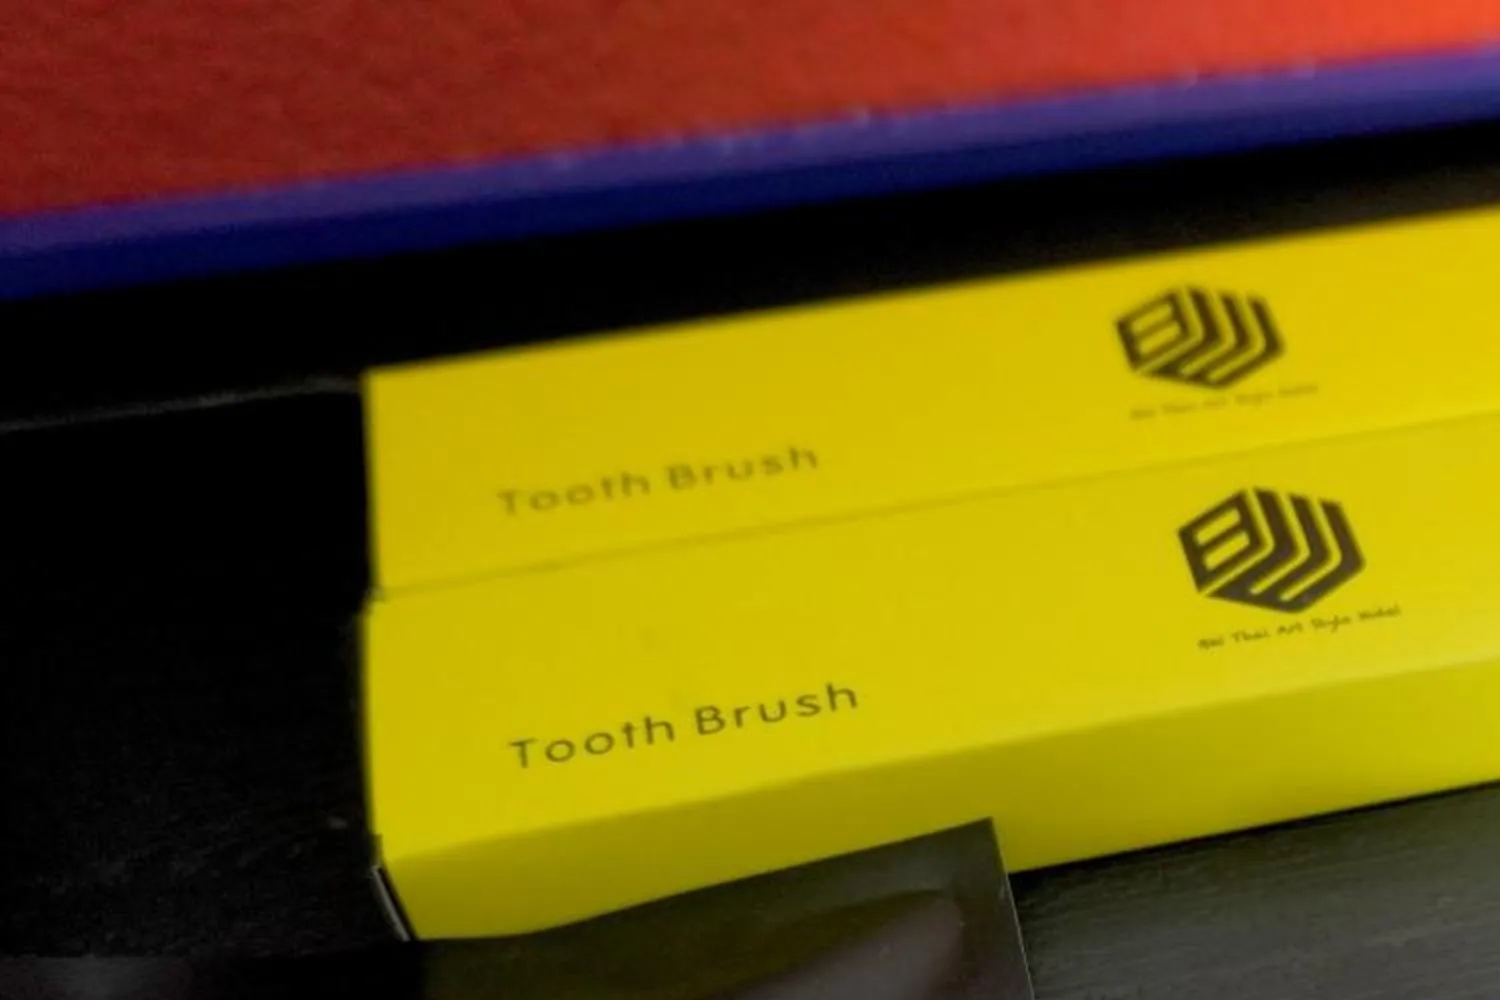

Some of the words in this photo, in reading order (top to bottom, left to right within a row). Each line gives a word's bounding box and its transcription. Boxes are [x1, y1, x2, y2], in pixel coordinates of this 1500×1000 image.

[497, 471, 651, 516] Tooth
[667, 446, 818, 490] Brush
[509, 715, 675, 768] Tooth
[694, 682, 858, 735] Brush
